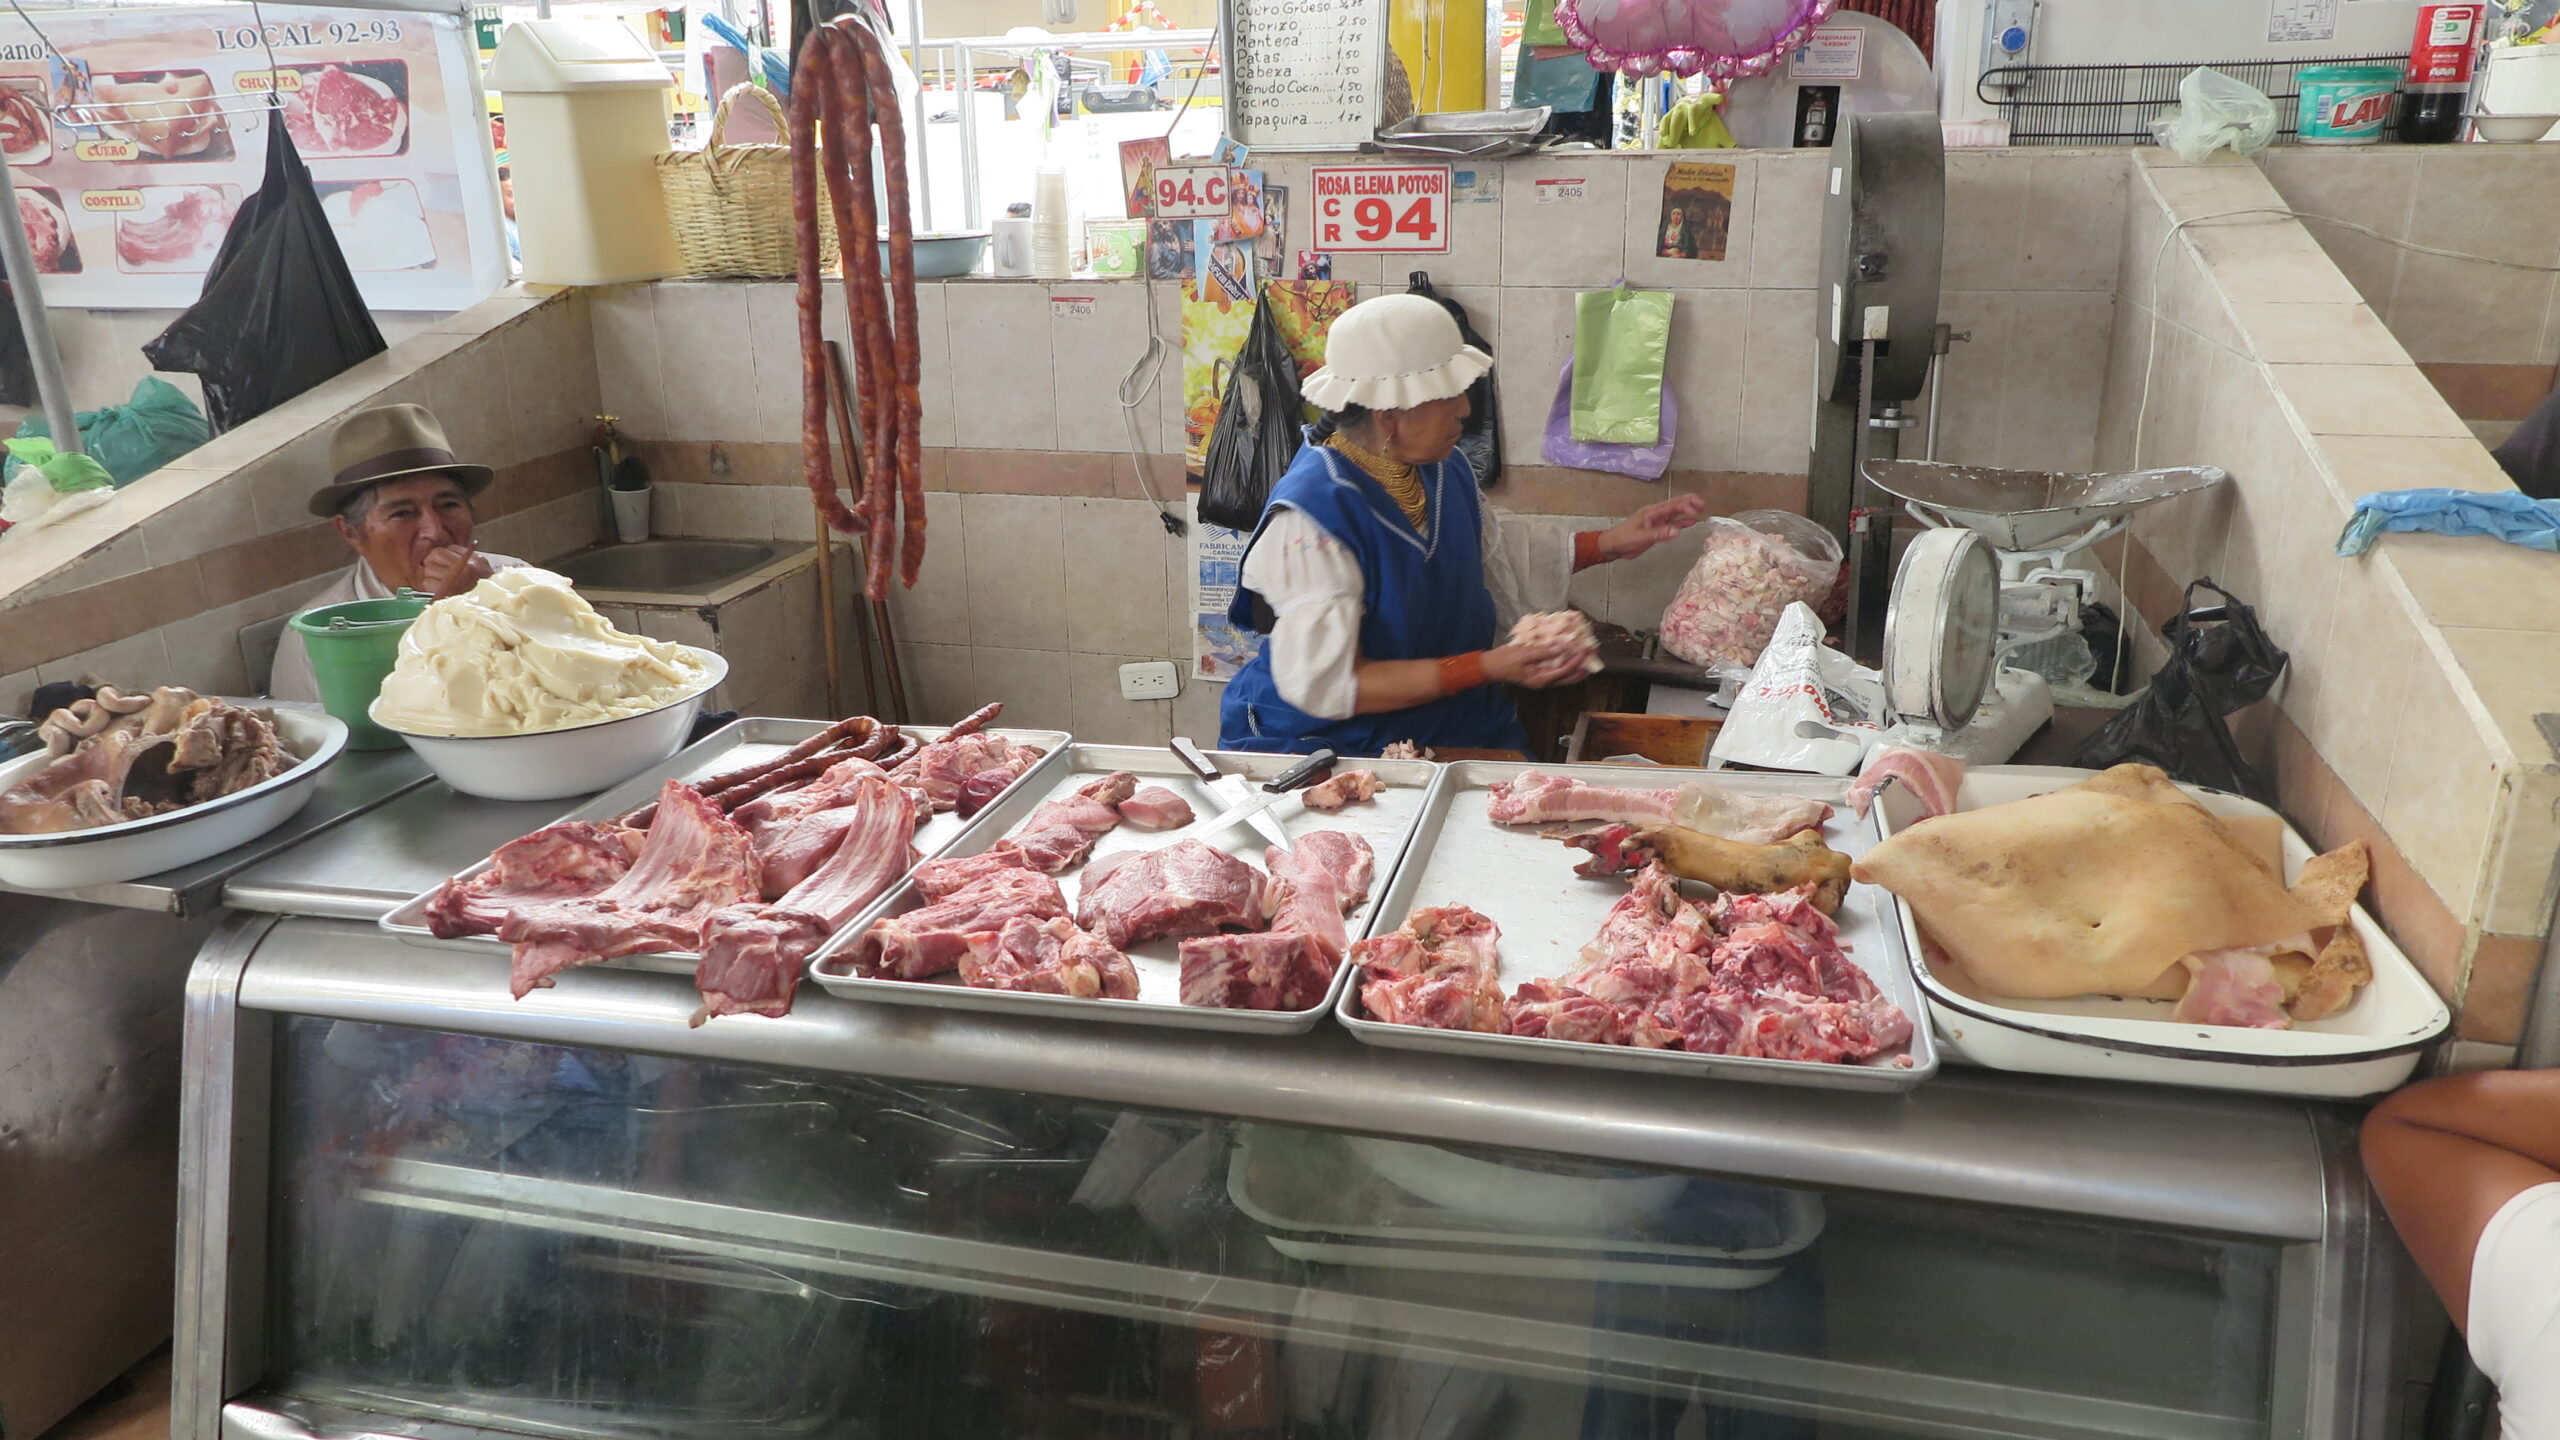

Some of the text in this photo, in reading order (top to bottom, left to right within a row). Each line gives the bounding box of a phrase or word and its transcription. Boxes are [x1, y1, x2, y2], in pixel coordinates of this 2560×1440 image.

[1236, 3, 1279, 16] Cuero
[1283, 1, 1330, 15] Grueso
[1236, 15, 1367, 34] Chorizo 2.50
[215, 20, 401, 50] LOCAL 92-93
[1338, 31, 1363, 44] 1.75
[1236, 49, 1360, 65] Patas 1.50
[1335, 63, 1360, 76] 1.50
[239, 75, 299, 90] CHULETA
[1235, 80, 1285, 95] Menudo
[1338, 79, 1362, 94] 1.50
[1235, 94, 1364, 109] Tocino 1.50
[87, 145, 128, 157] CUERO
[1158, 177, 1226, 207] 94.C
[1318, 174, 1443, 195] ROSA ELENA POTOSI
[1557, 187, 1583, 198] 2405
[84, 195, 142, 208] COSTILLA
[1323, 198, 1341, 217] C
[1354, 197, 1437, 242] 94
[1324, 223, 1341, 242] R
